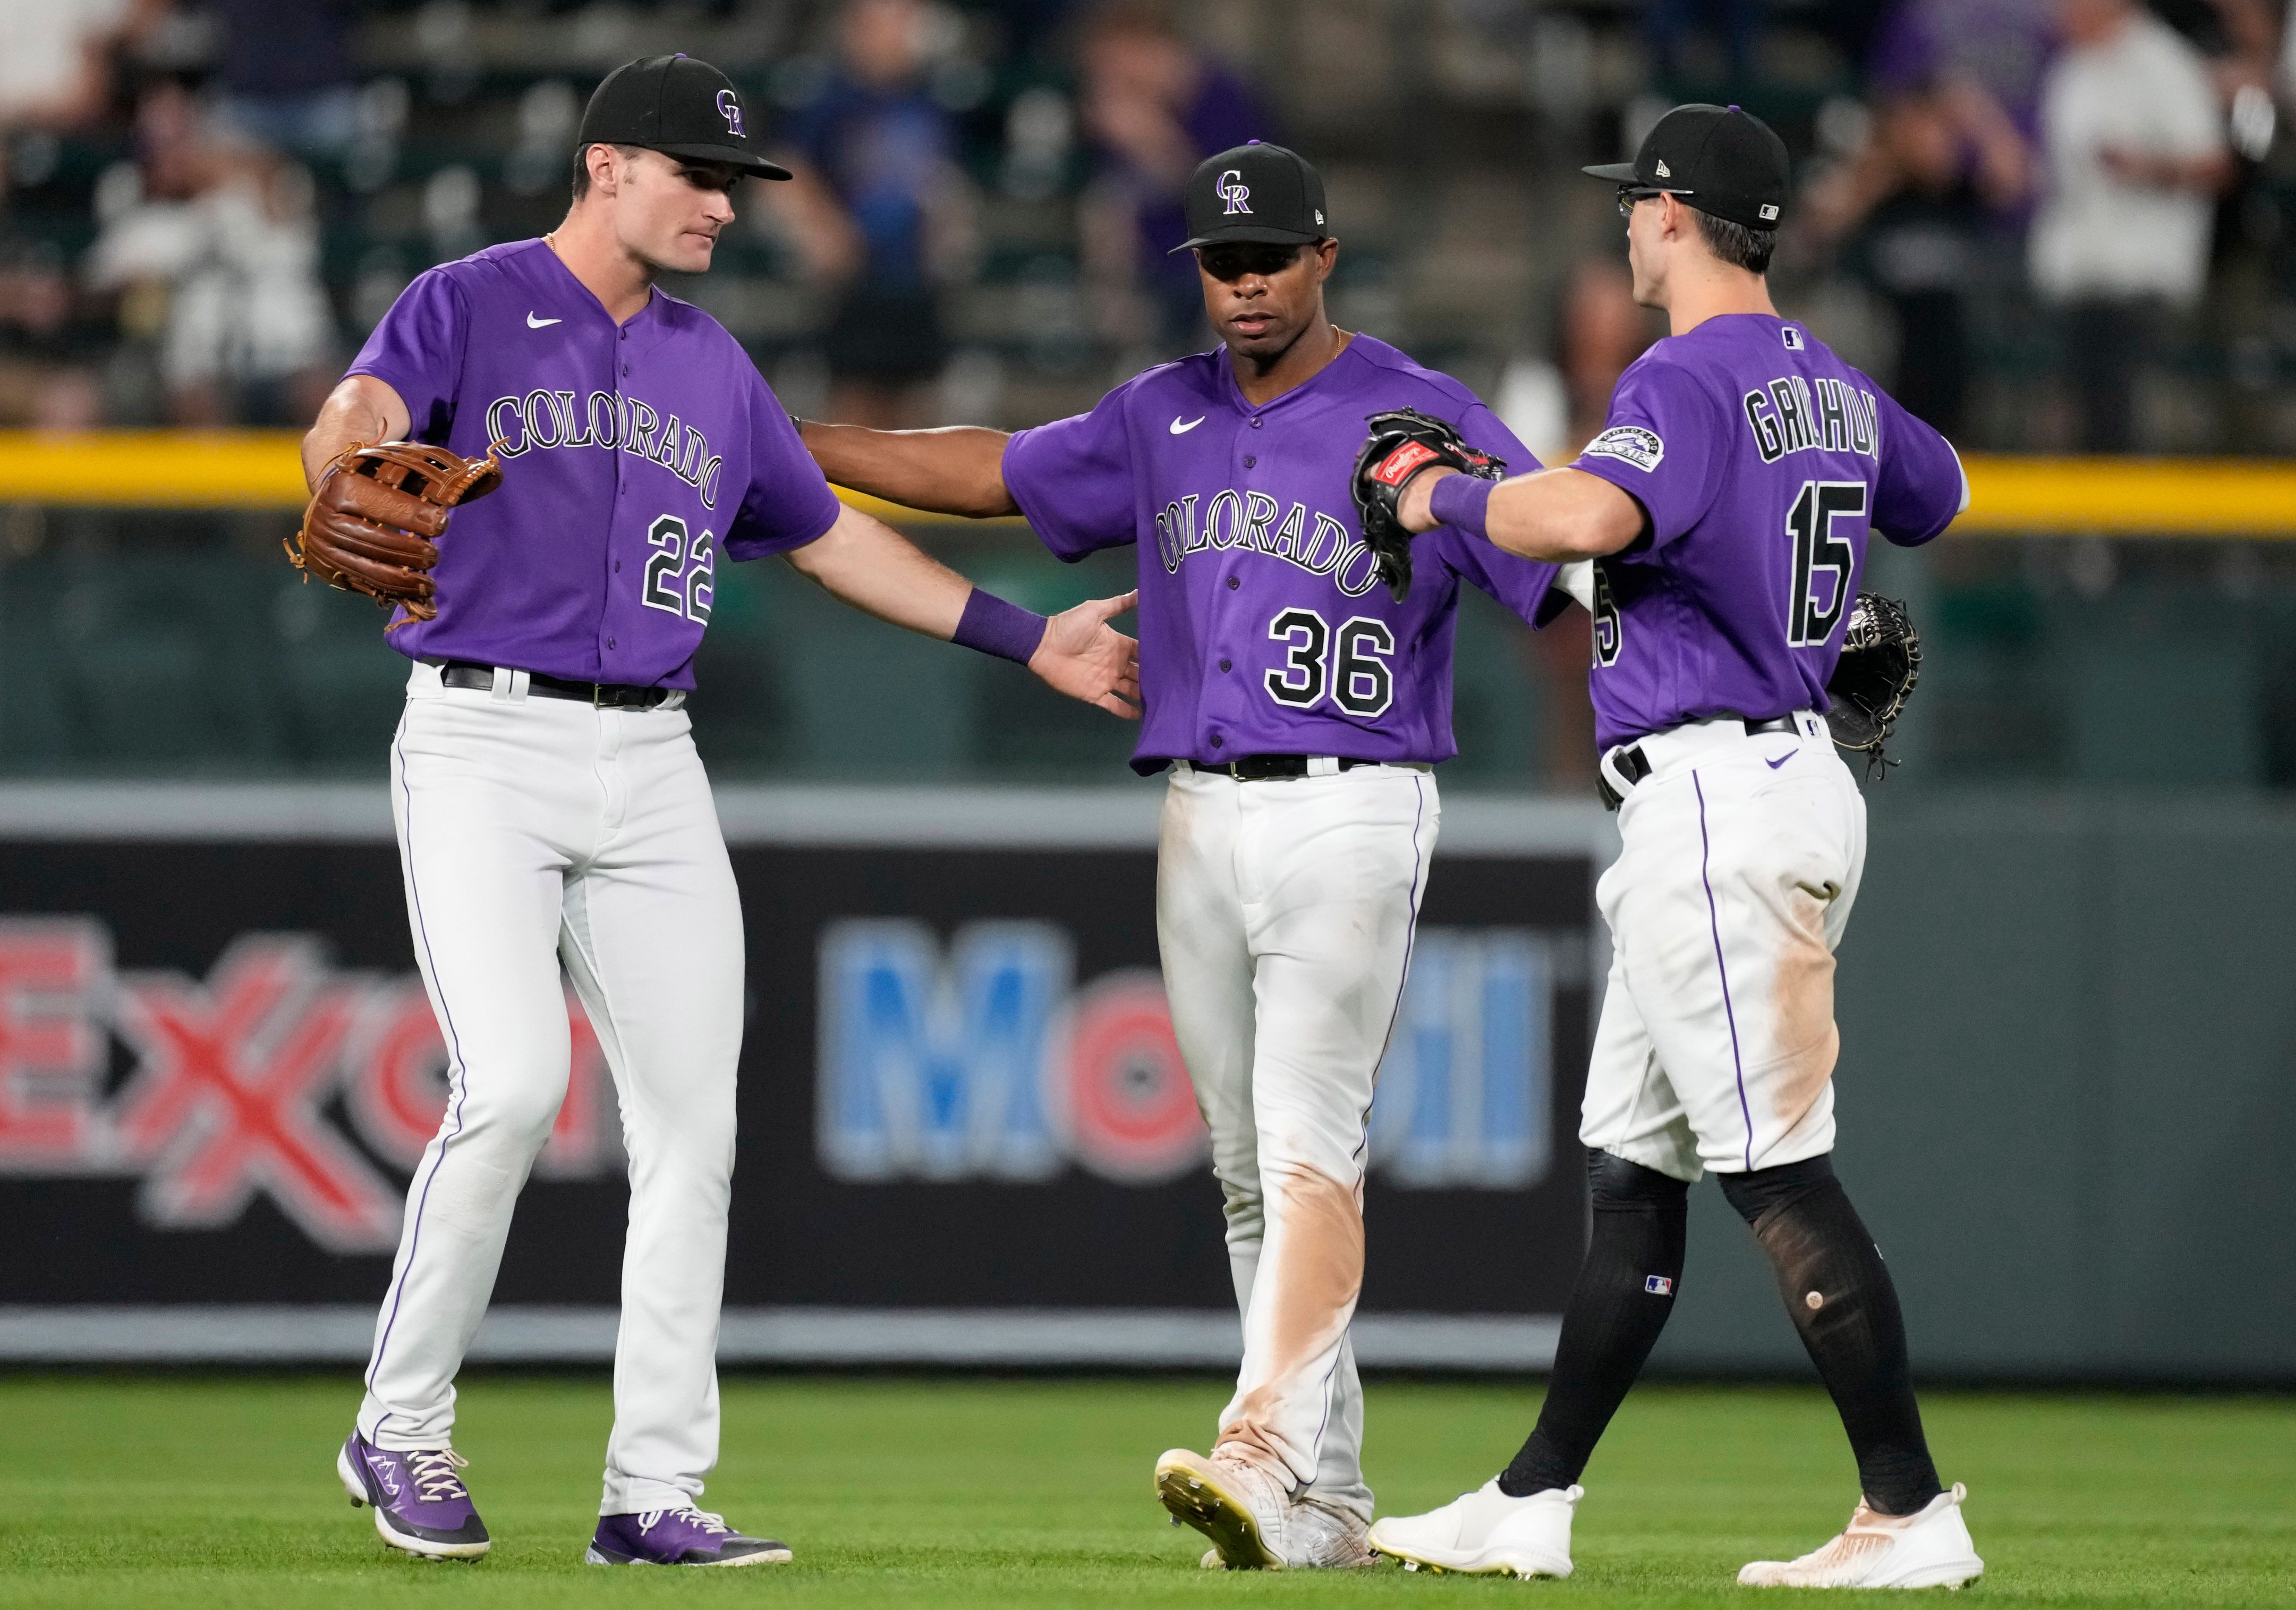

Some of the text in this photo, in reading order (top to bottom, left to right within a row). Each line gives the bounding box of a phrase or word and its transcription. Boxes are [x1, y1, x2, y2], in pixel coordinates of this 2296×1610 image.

[1216, 170, 1254, 215] CR
[486, 389, 721, 510] COLORADO
[1594, 442, 1655, 464] ROCKIES
[1604, 428, 1658, 451] COLORADO
[642, 514, 713, 627] 22
[1154, 489, 1381, 597] COLORADO
[1785, 480, 1867, 648] 15
[1264, 607, 1394, 717] 36
[1591, 567, 1622, 670] 5
[815, 915, 1551, 1190] Moil
